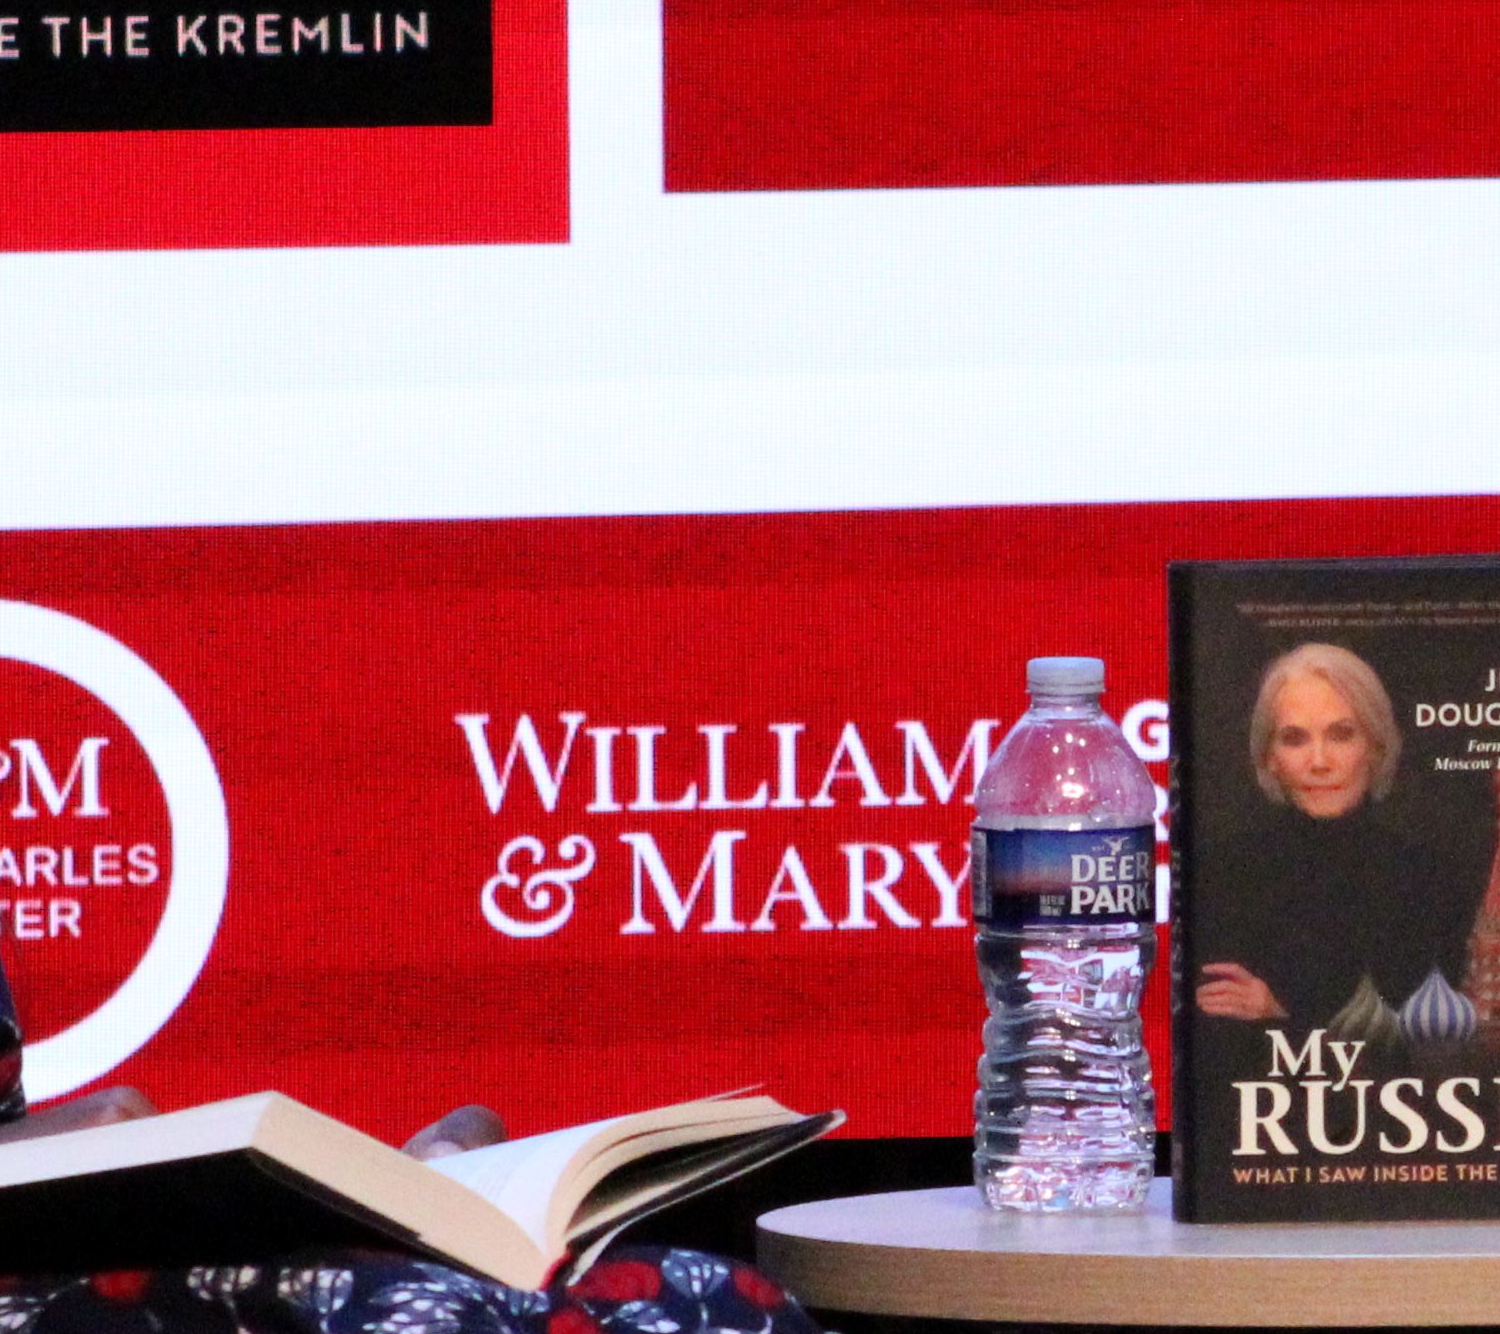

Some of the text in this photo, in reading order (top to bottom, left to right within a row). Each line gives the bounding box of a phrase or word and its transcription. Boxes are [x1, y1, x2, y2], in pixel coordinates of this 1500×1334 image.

[43, 16, 148, 57] THE
[177, 12, 427, 56] KREMLIN
[454, 712, 998, 814] WILLIAM
[1434, 757, 1492, 771] Moscow
[481, 835, 595, 937] &
[620, 828, 973, 935] MARY
[1071, 851, 1150, 883] DEER
[1070, 882, 1150, 915] PARK
[1265, 1029, 1366, 1091] My
[1233, 1168, 1299, 1183] WHAT
[1305, 1168, 1311, 1183] I
[1319, 1167, 1367, 1183] SAW
[1374, 1165, 1449, 1182] INSIDE
[1455, 1164, 1498, 1180] THE
